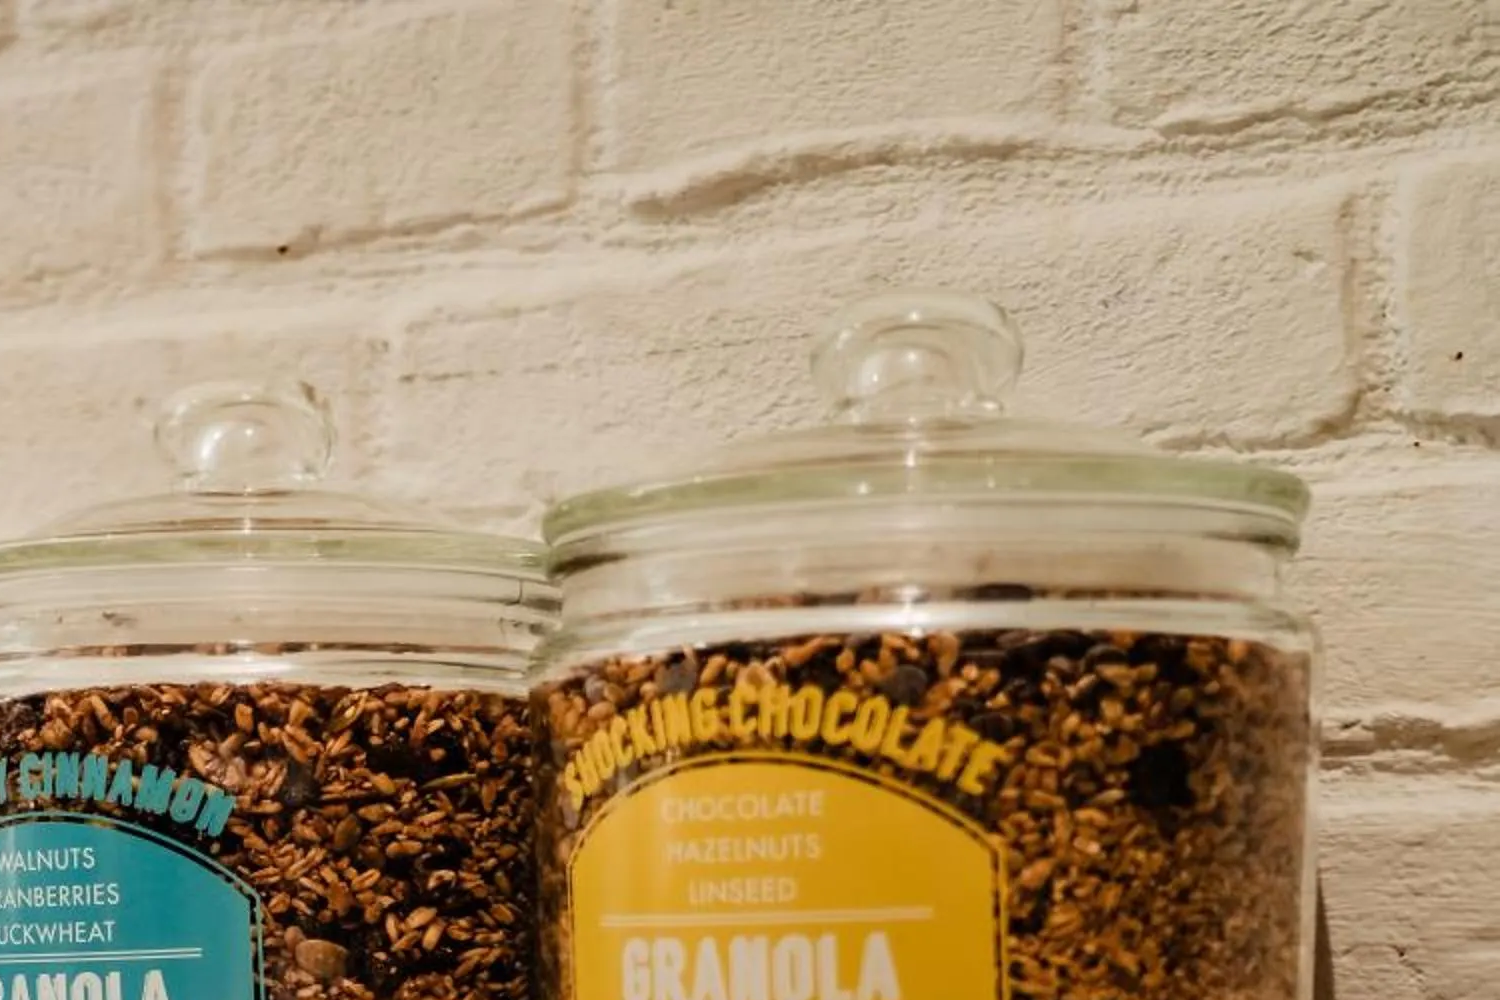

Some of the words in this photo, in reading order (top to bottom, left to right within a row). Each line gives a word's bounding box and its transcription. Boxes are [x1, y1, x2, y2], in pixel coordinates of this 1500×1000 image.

[564, 687, 719, 812] SHOCKING
[728, 683, 1006, 796] CHOCOLATE
[19, 751, 237, 837] CINNAMON
[661, 790, 824, 824] CHOCOLATE
[664, 833, 822, 864] HAZELNUTS
[688, 877, 798, 905] LINSEED
